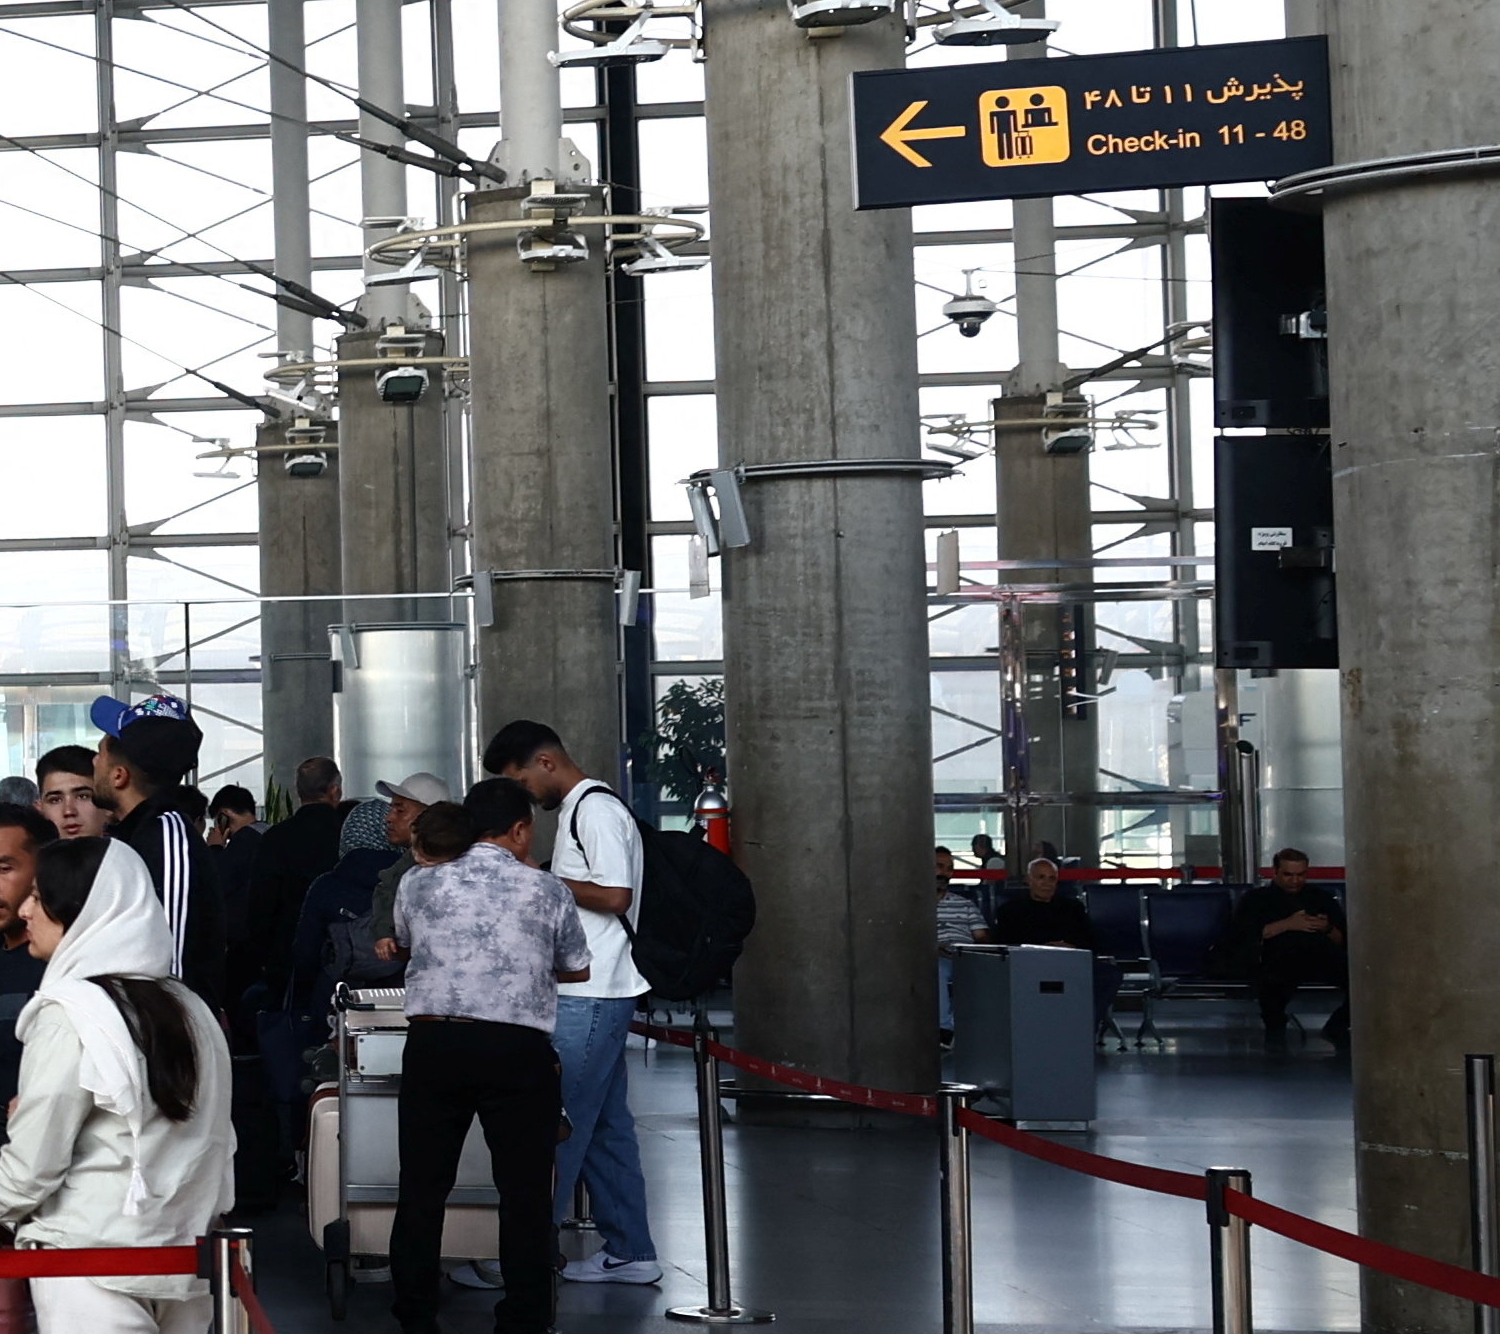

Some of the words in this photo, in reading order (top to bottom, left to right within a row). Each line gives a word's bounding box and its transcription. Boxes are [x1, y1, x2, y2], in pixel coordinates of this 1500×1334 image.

[1084, 88, 1124, 111] ۴۸
[1131, 83, 1152, 105] تا
[1163, 83, 1194, 104] ۱۱
[1206, 72, 1305, 106] پذیرش
[1086, 128, 1202, 157] Check-in
[1218, 125, 1246, 145] 11
[1271, 119, 1307, 142] 48
